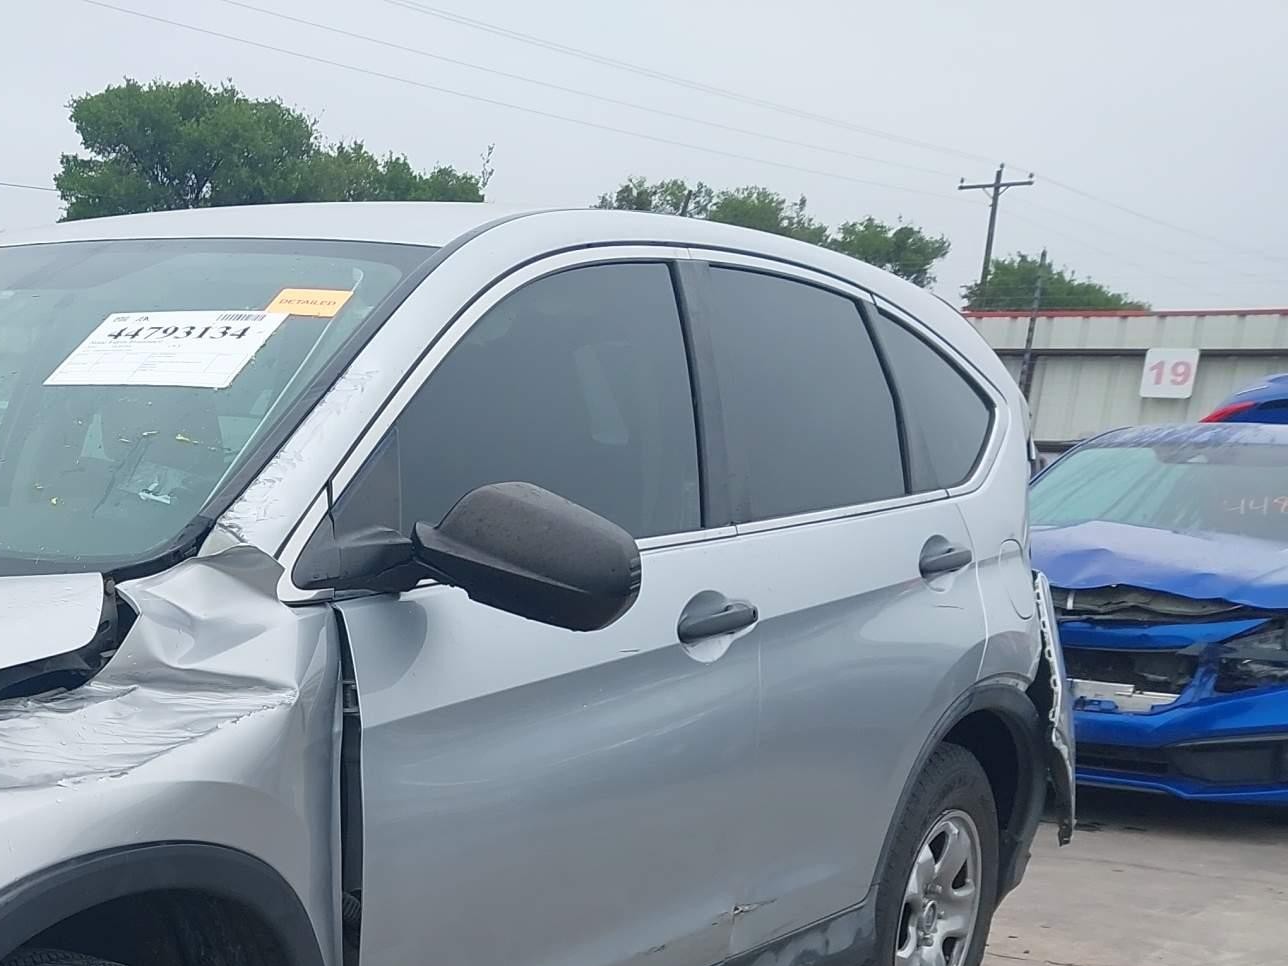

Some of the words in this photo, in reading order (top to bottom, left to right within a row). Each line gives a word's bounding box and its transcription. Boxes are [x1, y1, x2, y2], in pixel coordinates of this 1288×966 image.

[278, 298, 337, 306] DETAILED
[107, 326, 251, 340] 44793134
[1149, 360, 1192, 386] 19
